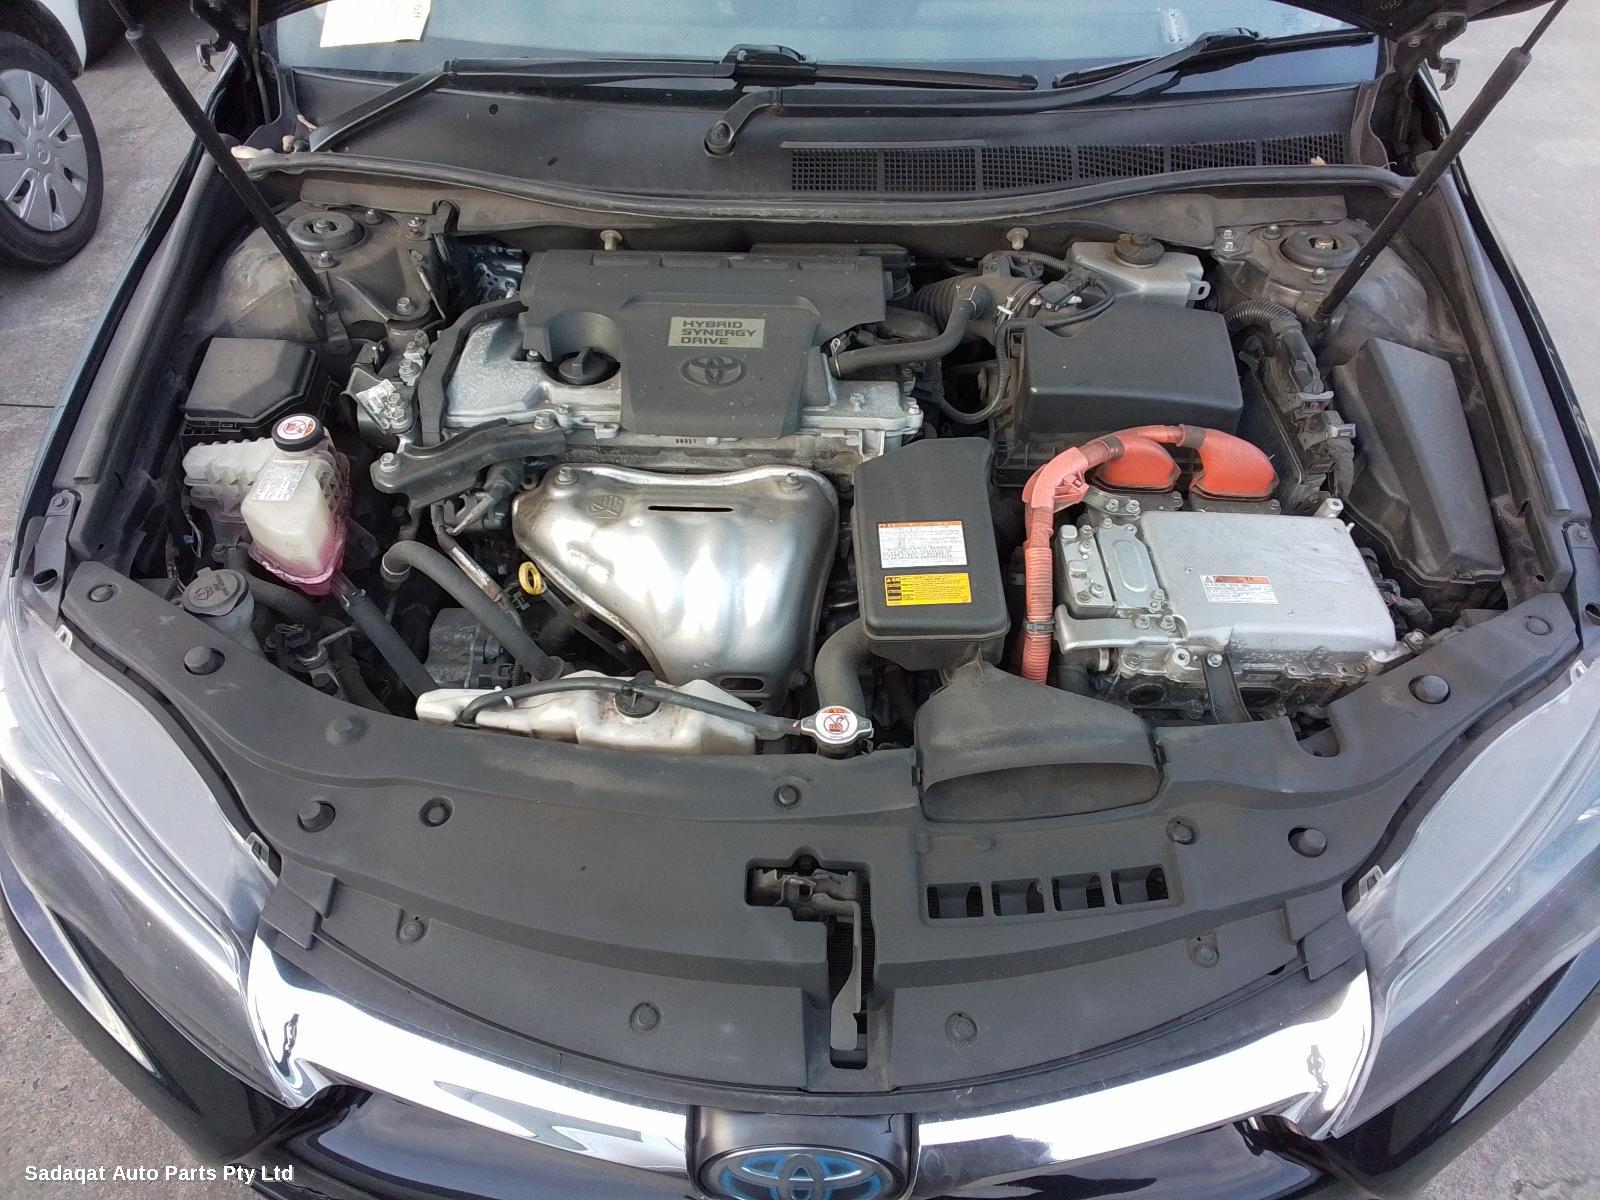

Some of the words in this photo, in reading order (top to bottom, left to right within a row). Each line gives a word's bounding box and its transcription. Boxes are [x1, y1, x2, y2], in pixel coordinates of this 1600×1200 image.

[682, 320, 744, 329] HYBRID
[681, 328, 758, 337] SYNERGY
[680, 336, 730, 345] DRIVE
